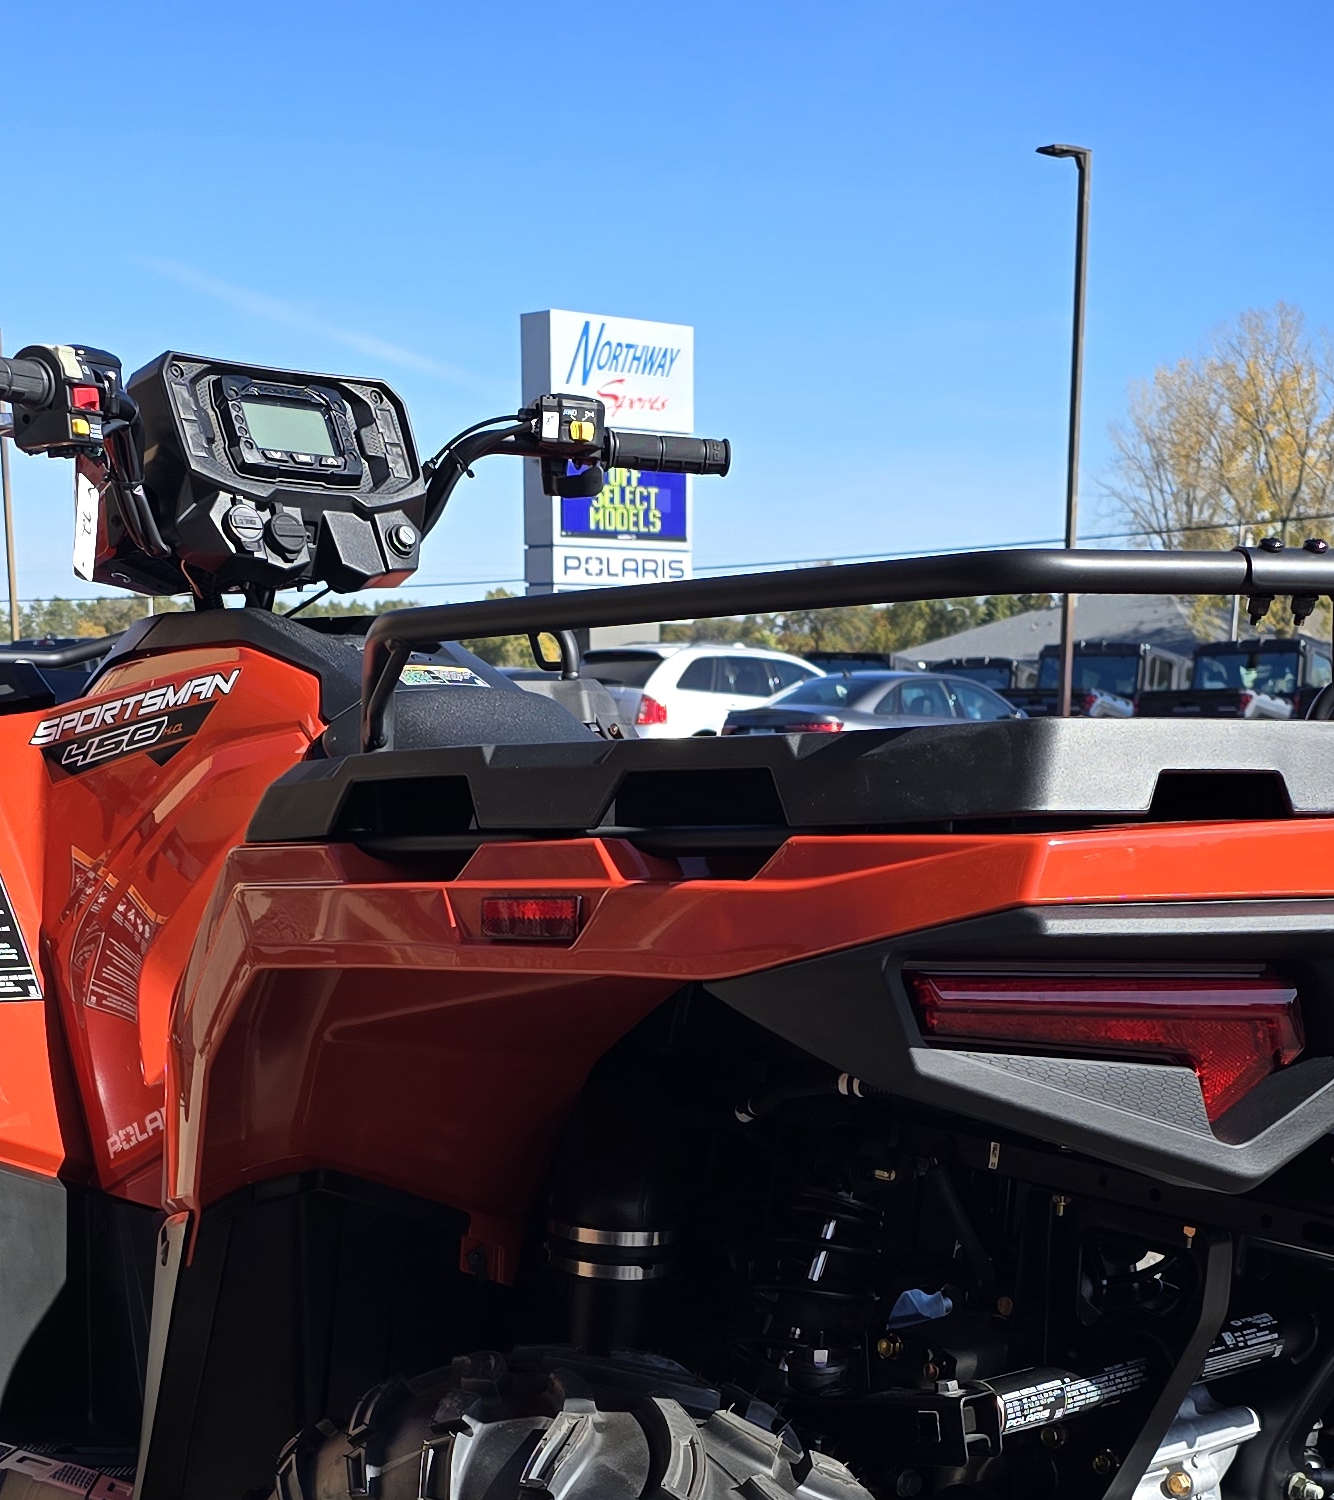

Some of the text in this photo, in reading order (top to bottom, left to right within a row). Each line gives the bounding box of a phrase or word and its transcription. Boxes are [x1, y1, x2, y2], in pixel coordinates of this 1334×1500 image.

[565, 321, 681, 386] NORTHWAY
[589, 506, 662, 534] MODELS
[592, 484, 659, 509] SELECT
[564, 555, 685, 579] POLARIS
[29, 669, 242, 745] SPORTSMAN
[62, 716, 168, 766] 450
[107, 1107, 165, 1159] POLA
